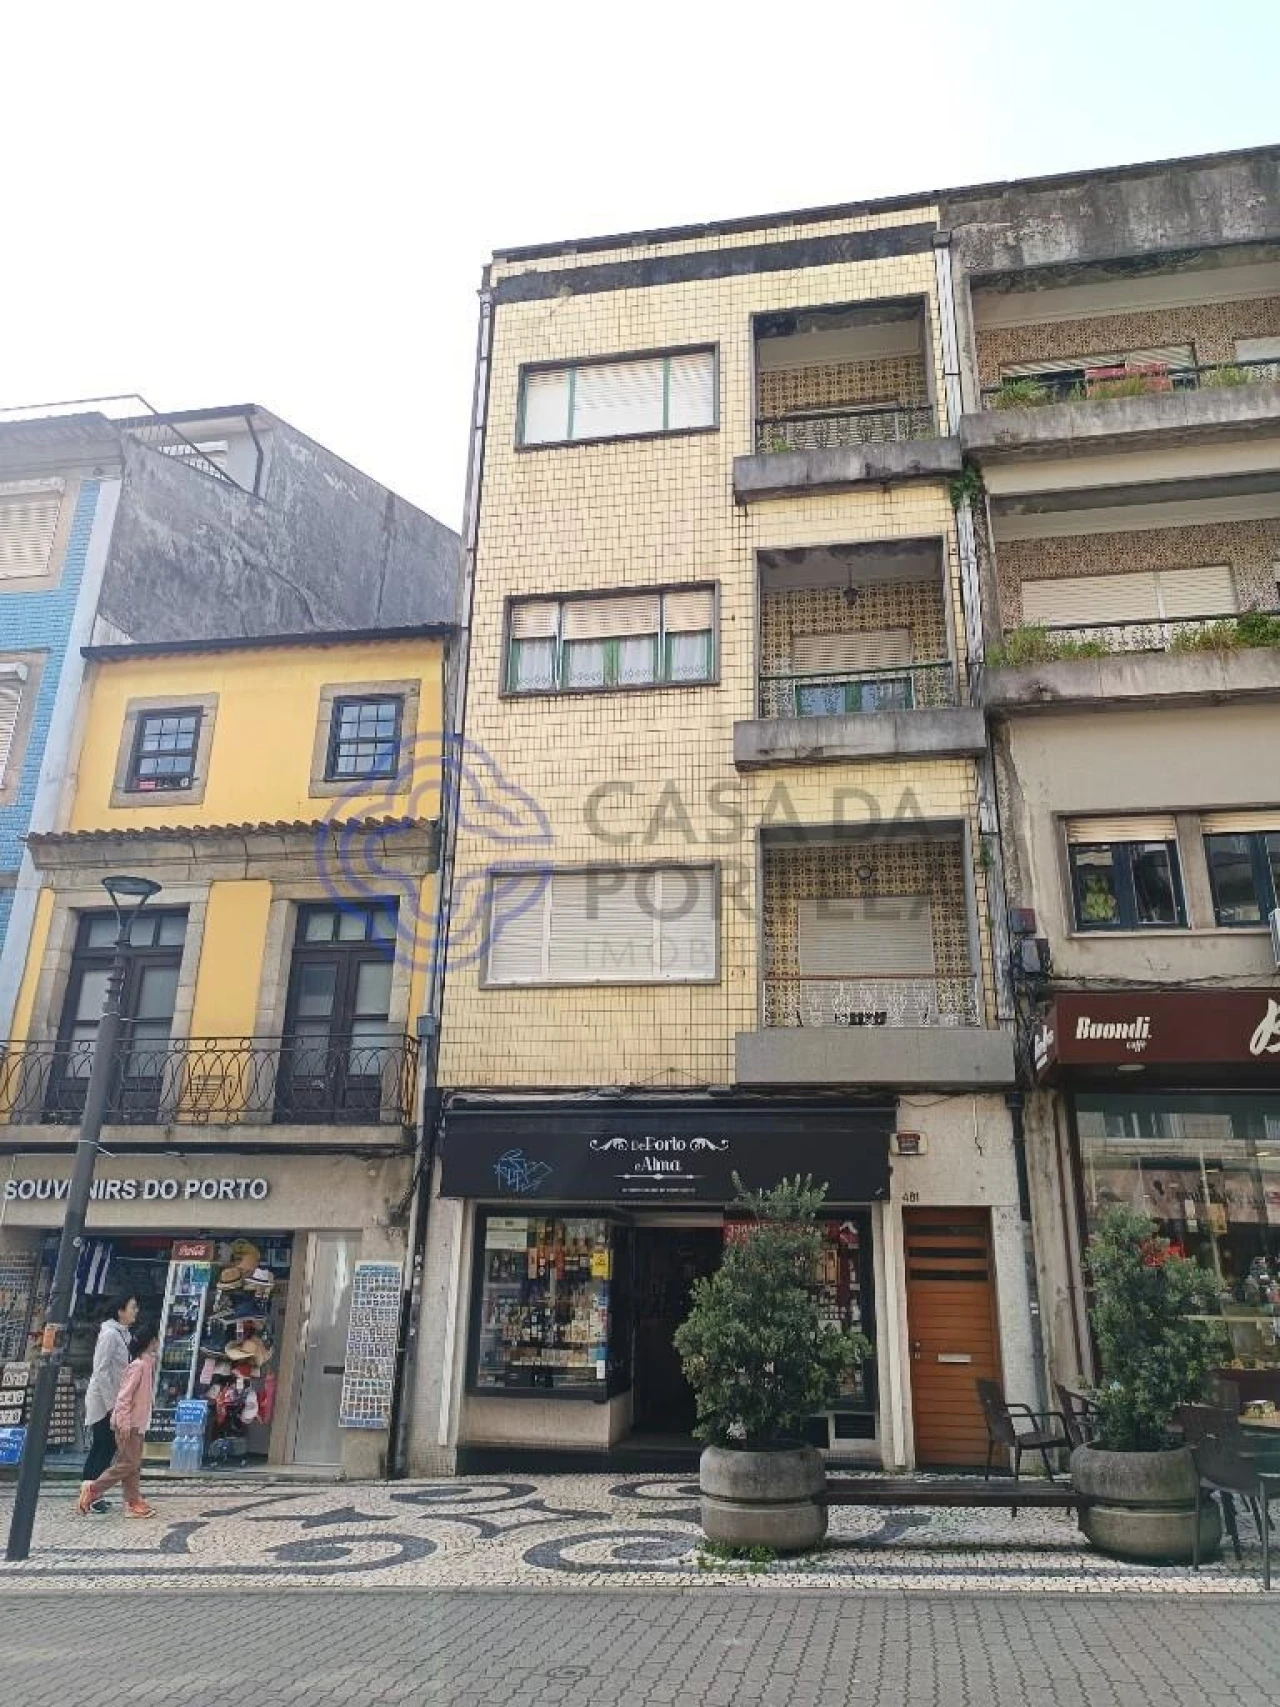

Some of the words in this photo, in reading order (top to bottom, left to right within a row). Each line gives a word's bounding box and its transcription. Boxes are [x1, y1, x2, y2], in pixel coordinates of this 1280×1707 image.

[4, 1179, 137, 1200] SOUVNIRS
[143, 1179, 178, 1200] DO
[185, 1179, 267, 1200] PORTO
